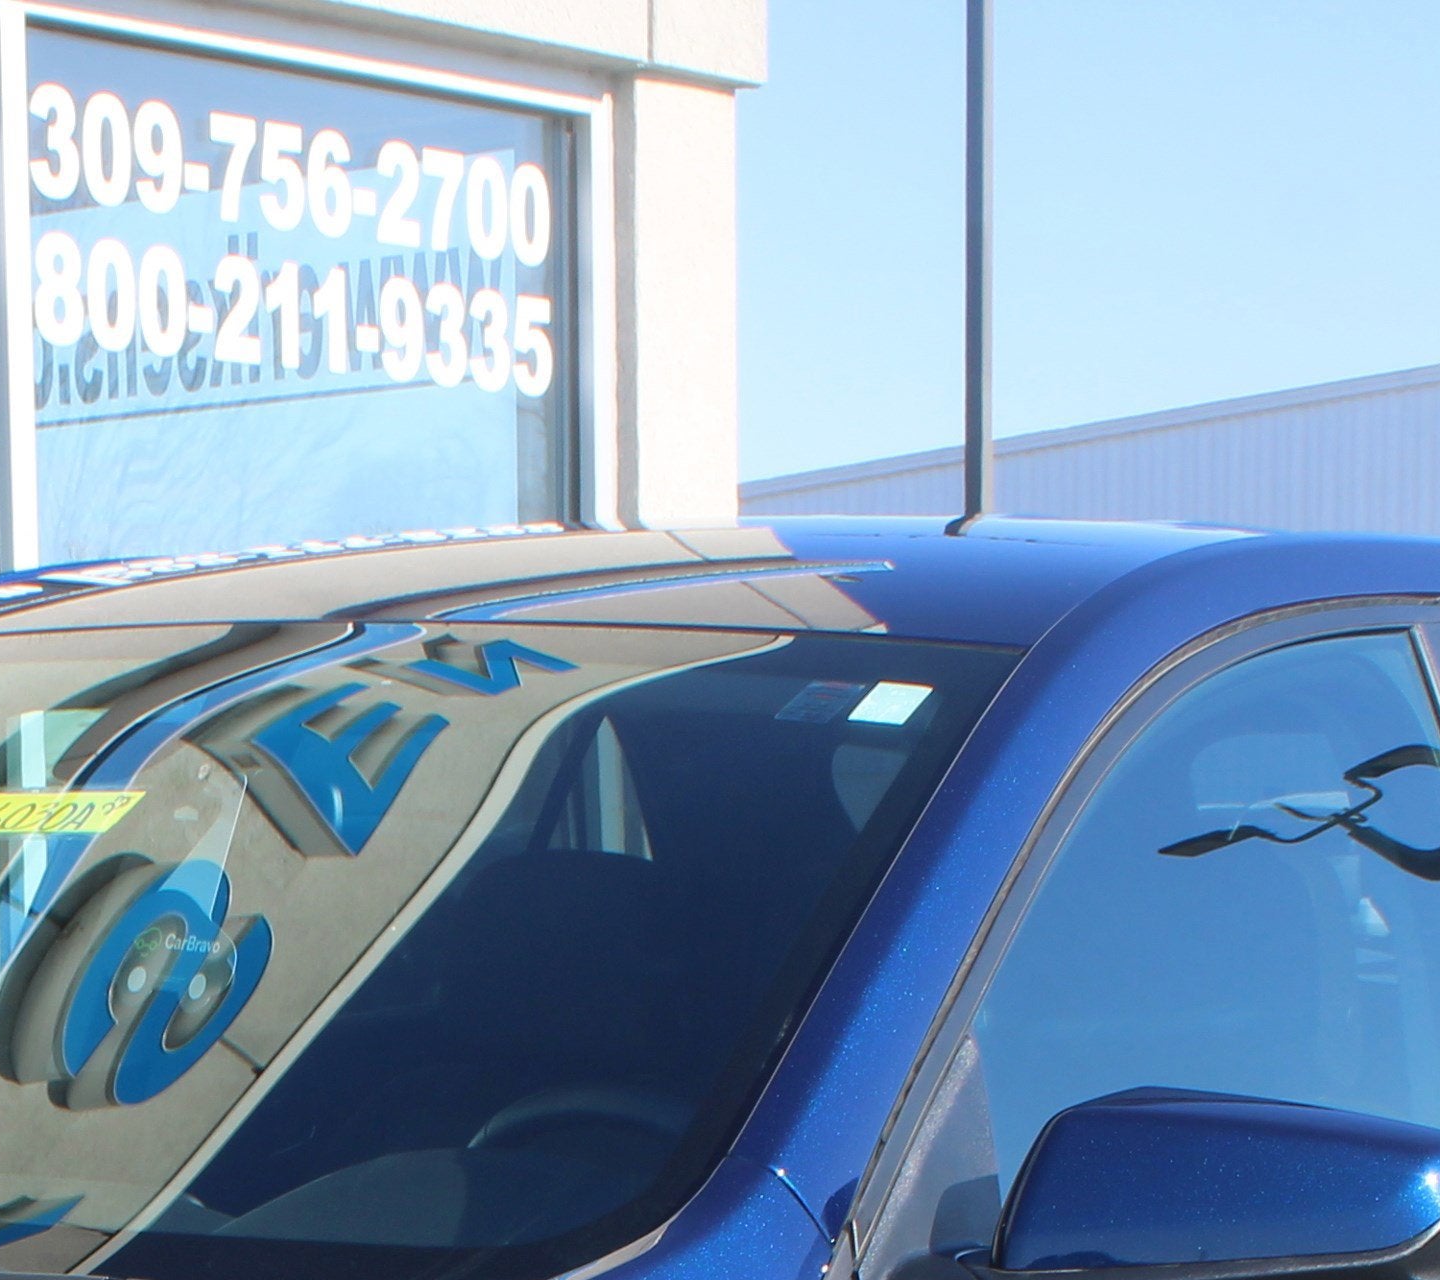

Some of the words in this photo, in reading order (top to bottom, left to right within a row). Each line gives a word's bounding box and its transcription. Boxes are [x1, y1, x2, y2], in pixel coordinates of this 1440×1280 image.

[28, 82, 551, 267] 309-756-2700
[33, 230, 553, 397] 800-211-9335
[164, 932, 221, 954] CarBravo
